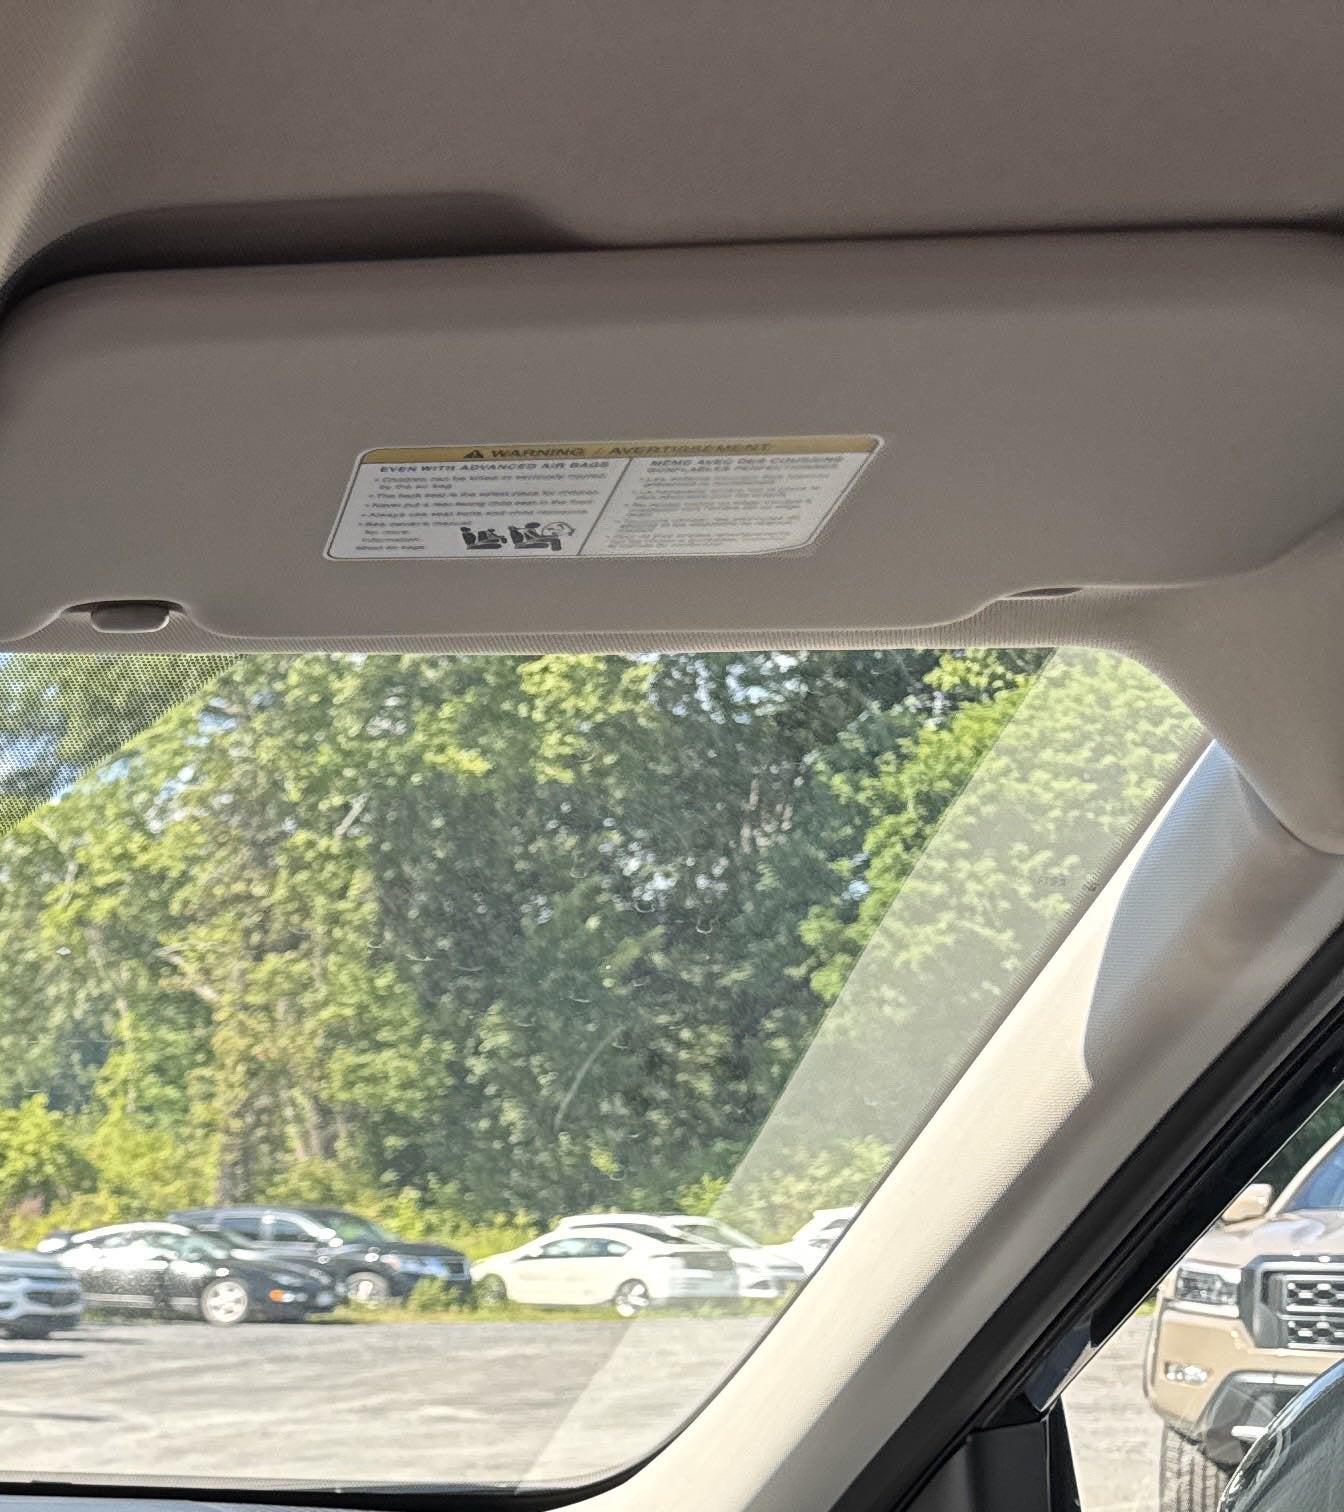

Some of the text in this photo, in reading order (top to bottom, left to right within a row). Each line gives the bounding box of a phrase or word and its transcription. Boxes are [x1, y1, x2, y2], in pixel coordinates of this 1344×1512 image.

[491, 448, 586, 458] WARNING
[379, 461, 610, 473] EVEN WITH ADVANCED AIR BAGS
